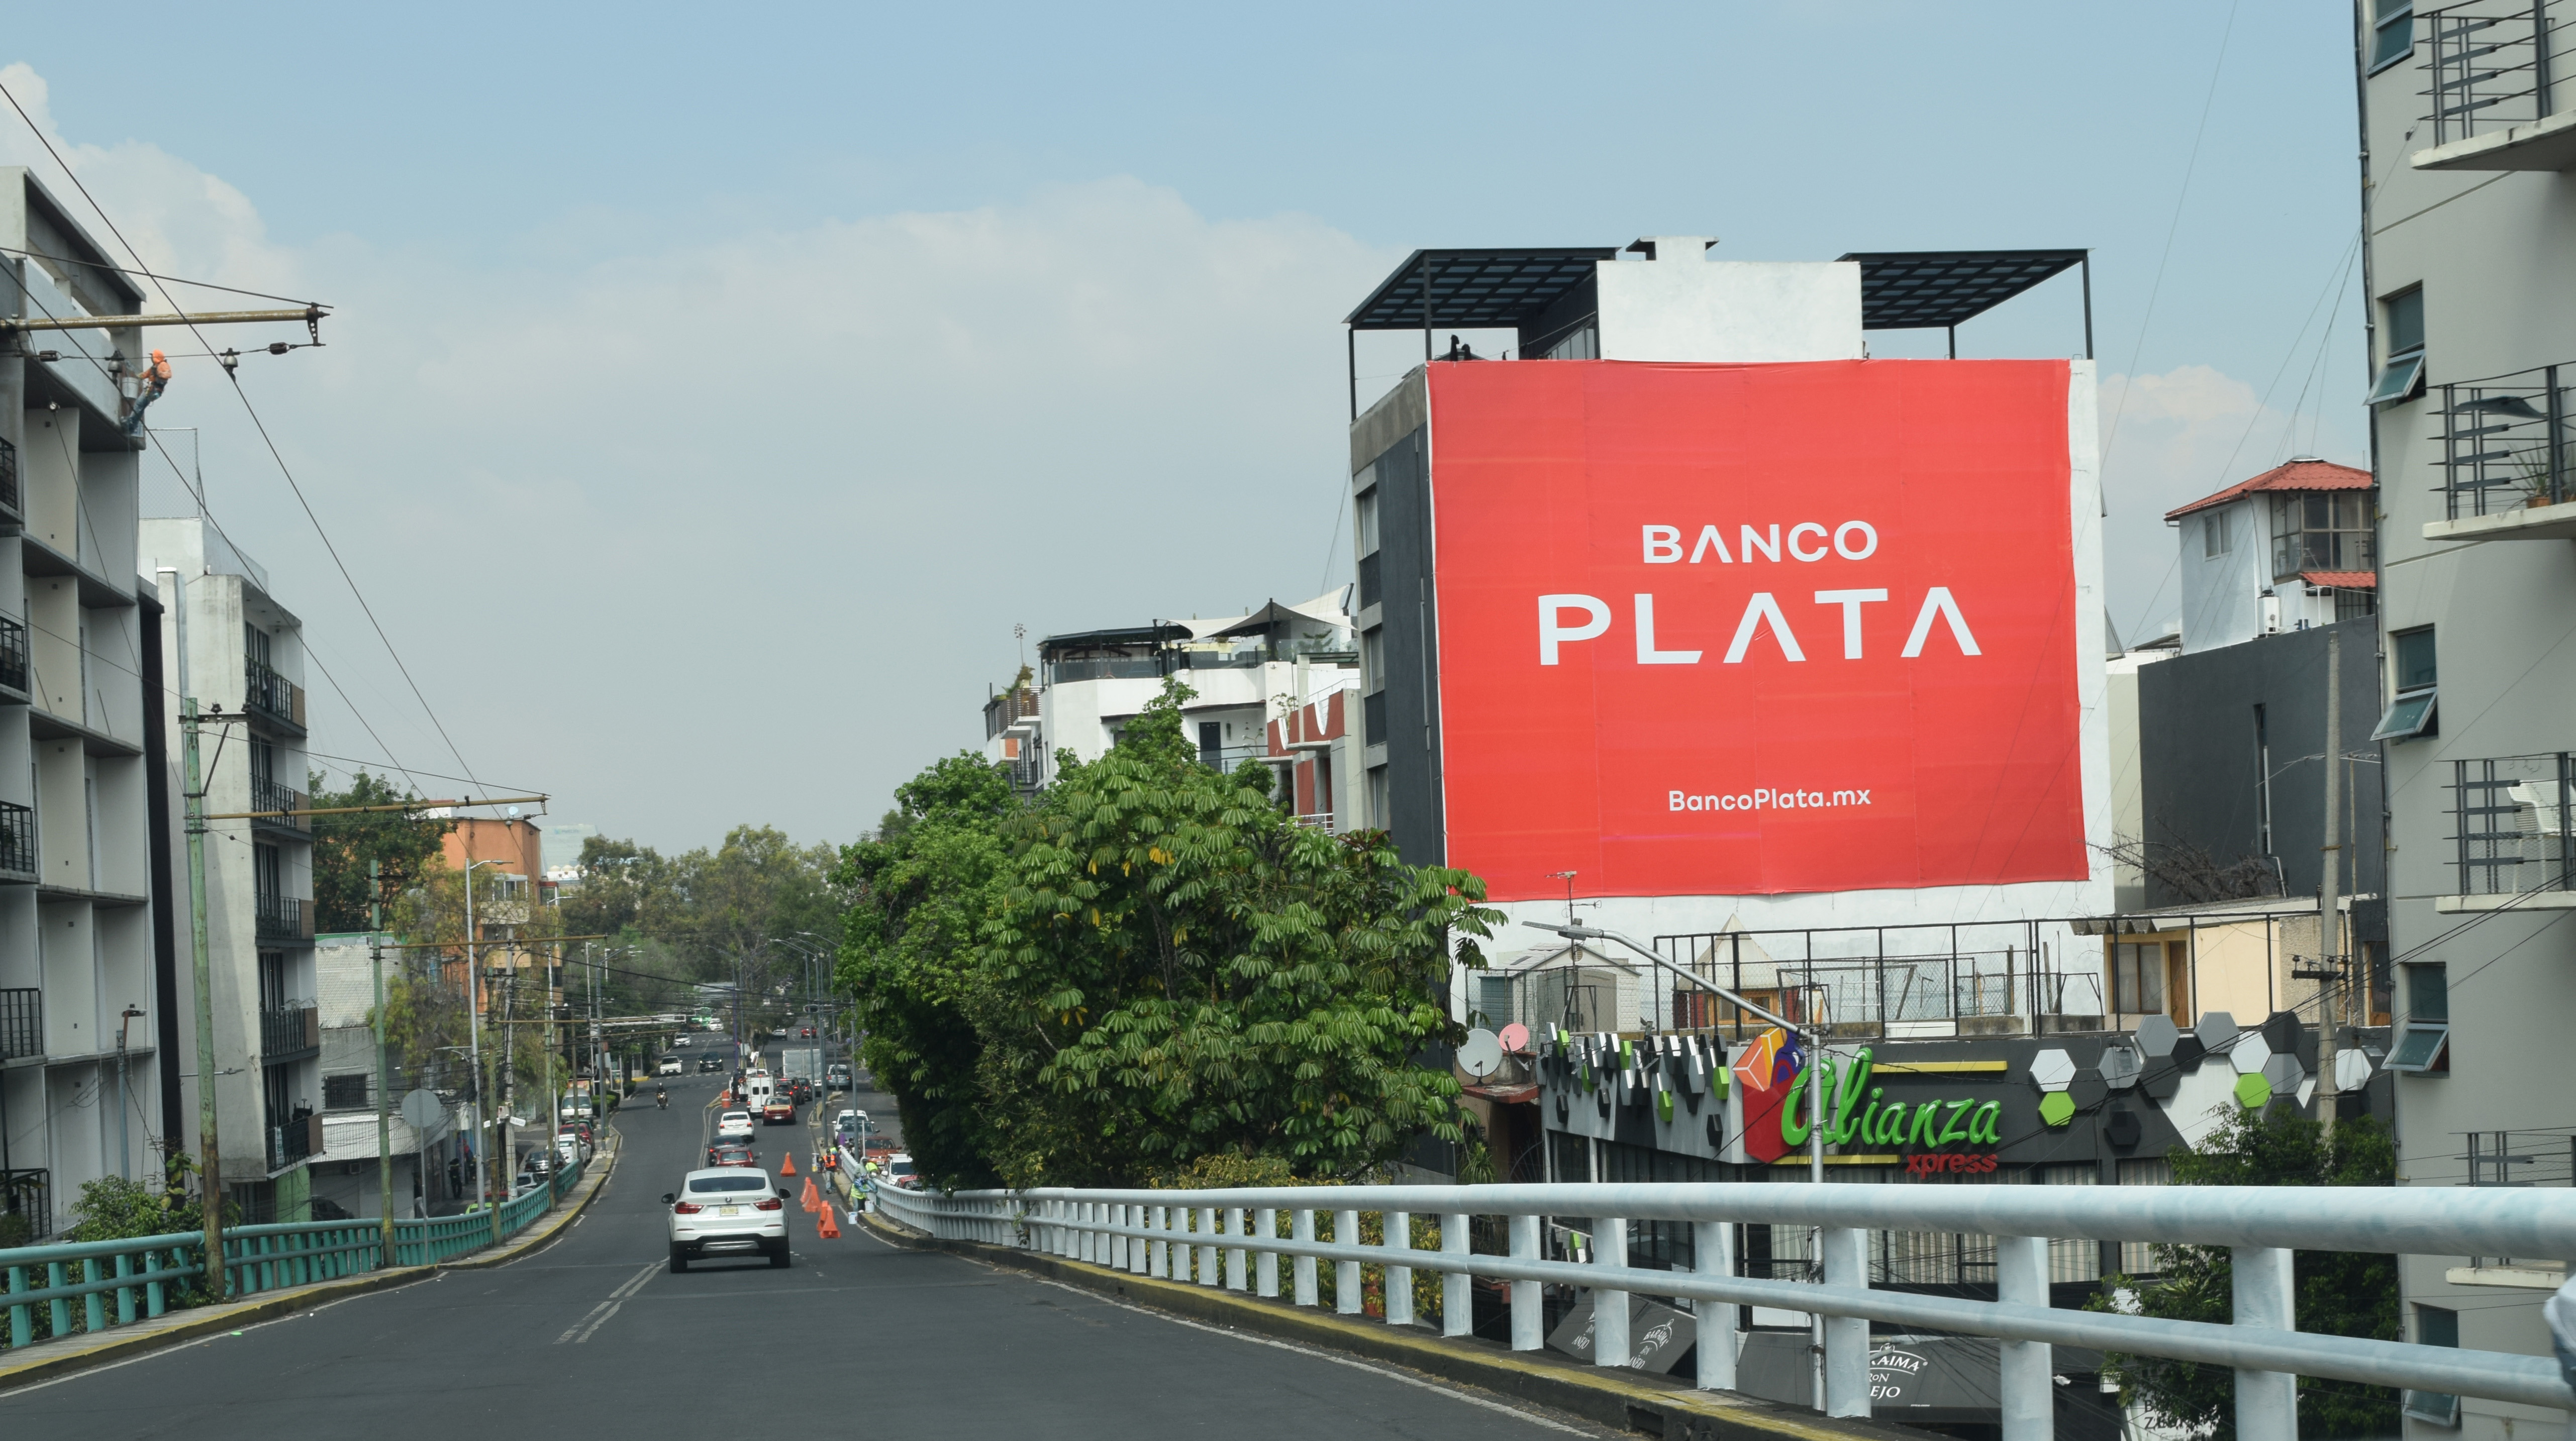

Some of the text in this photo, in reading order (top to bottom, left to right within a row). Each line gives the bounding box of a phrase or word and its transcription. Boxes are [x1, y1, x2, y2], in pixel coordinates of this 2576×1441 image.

[1642, 520, 1878, 563] BANCO
[1538, 586, 1982, 665] PLATA
[1669, 787, 1871, 811] BancoPlata.mx
[1905, 1154, 1998, 1179] xpress
